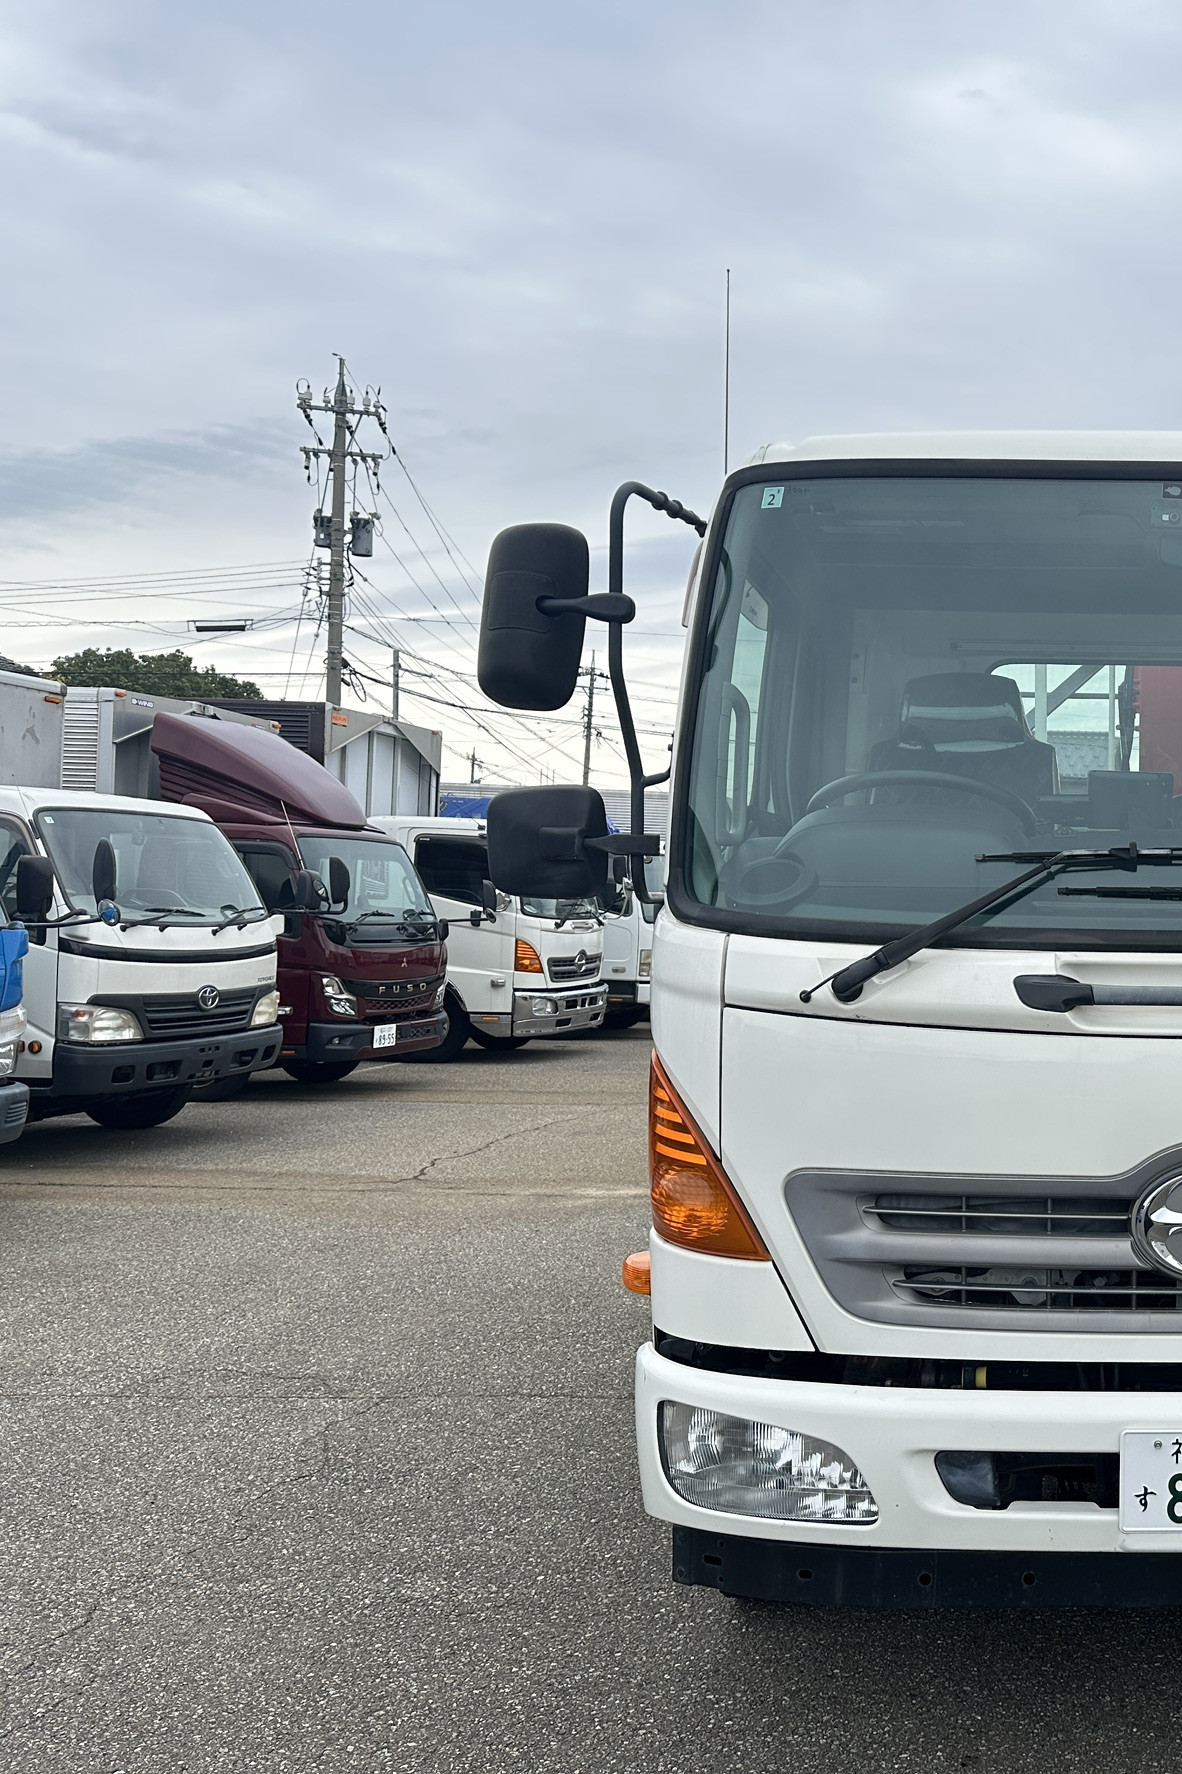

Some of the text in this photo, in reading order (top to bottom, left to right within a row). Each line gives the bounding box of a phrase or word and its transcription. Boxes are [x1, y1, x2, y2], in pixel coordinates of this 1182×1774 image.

[768, 494, 776, 506] 2
[378, 982, 427, 994] FUSO
[1134, 1486, 1157, 1512] す
